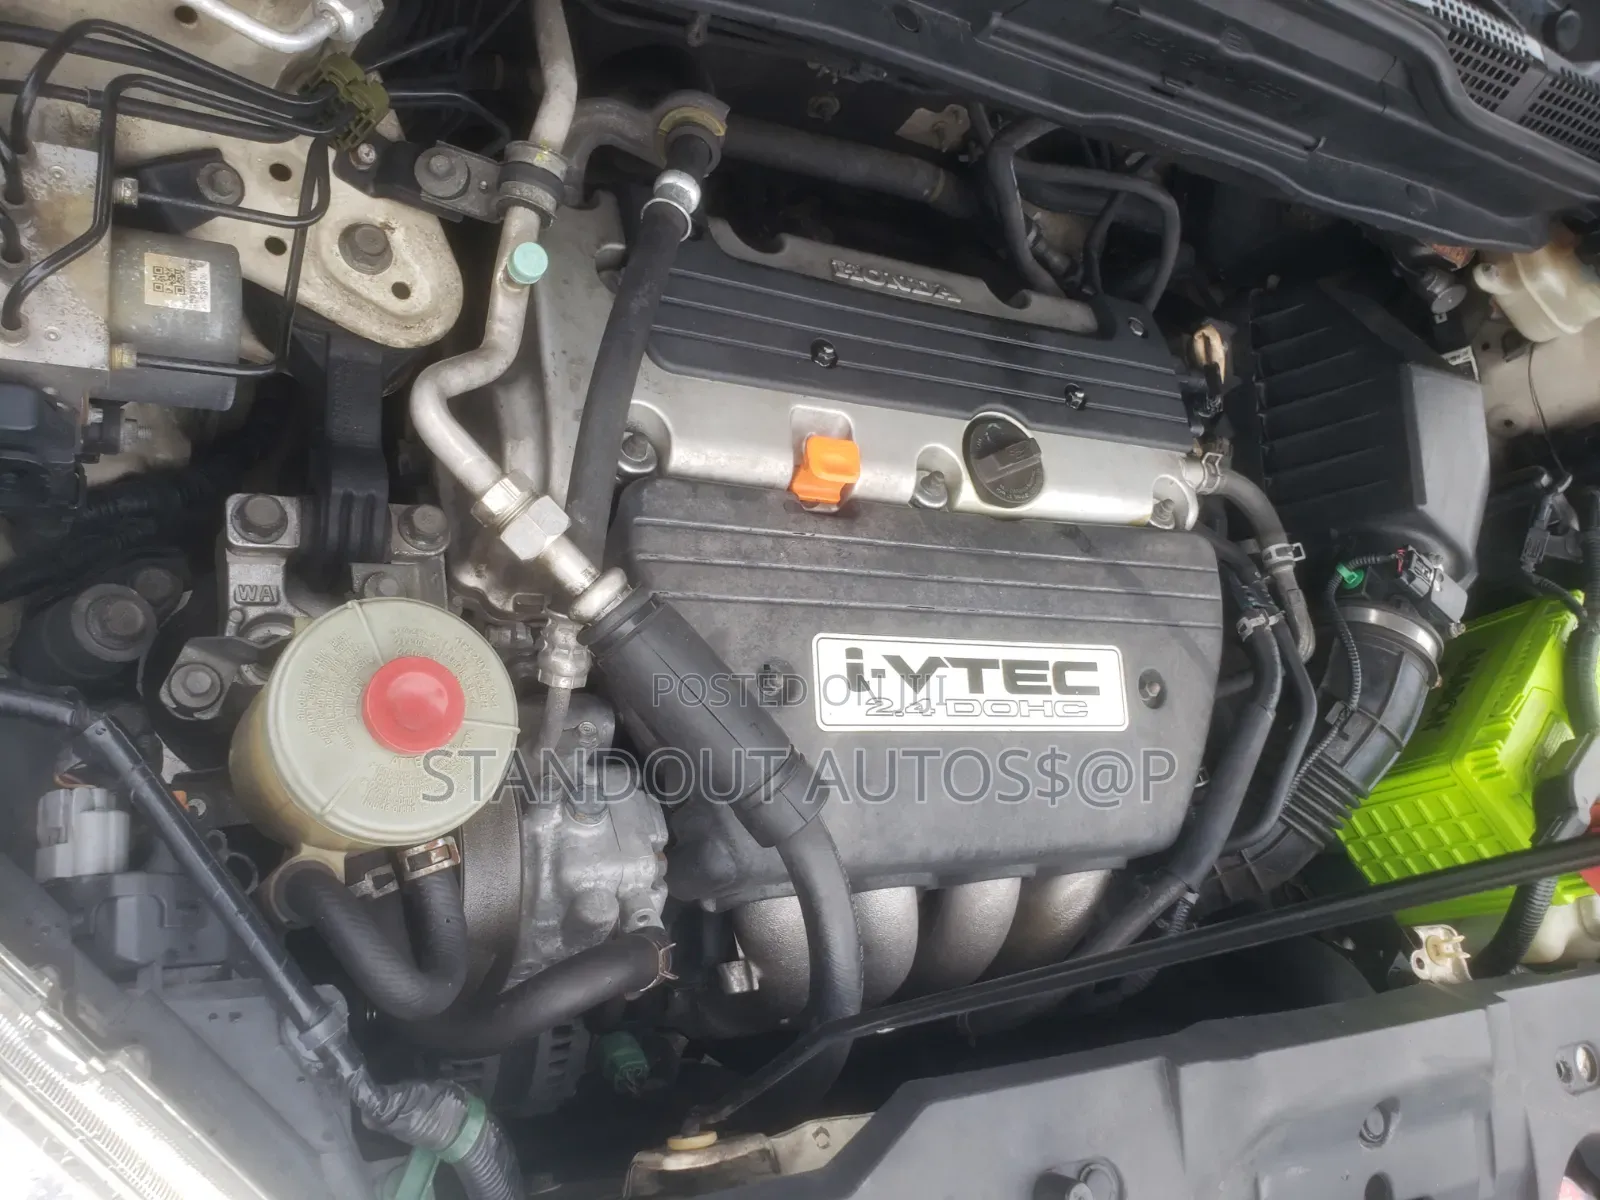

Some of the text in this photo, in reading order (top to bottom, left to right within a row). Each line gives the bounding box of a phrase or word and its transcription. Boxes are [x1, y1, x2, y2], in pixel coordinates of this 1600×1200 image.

[831, 259, 962, 303] HONDA
[238, 584, 274, 601] WA
[845, 647, 1100, 696] i-VTEC
[865, 696, 1088, 718] 2.4 DOHC
